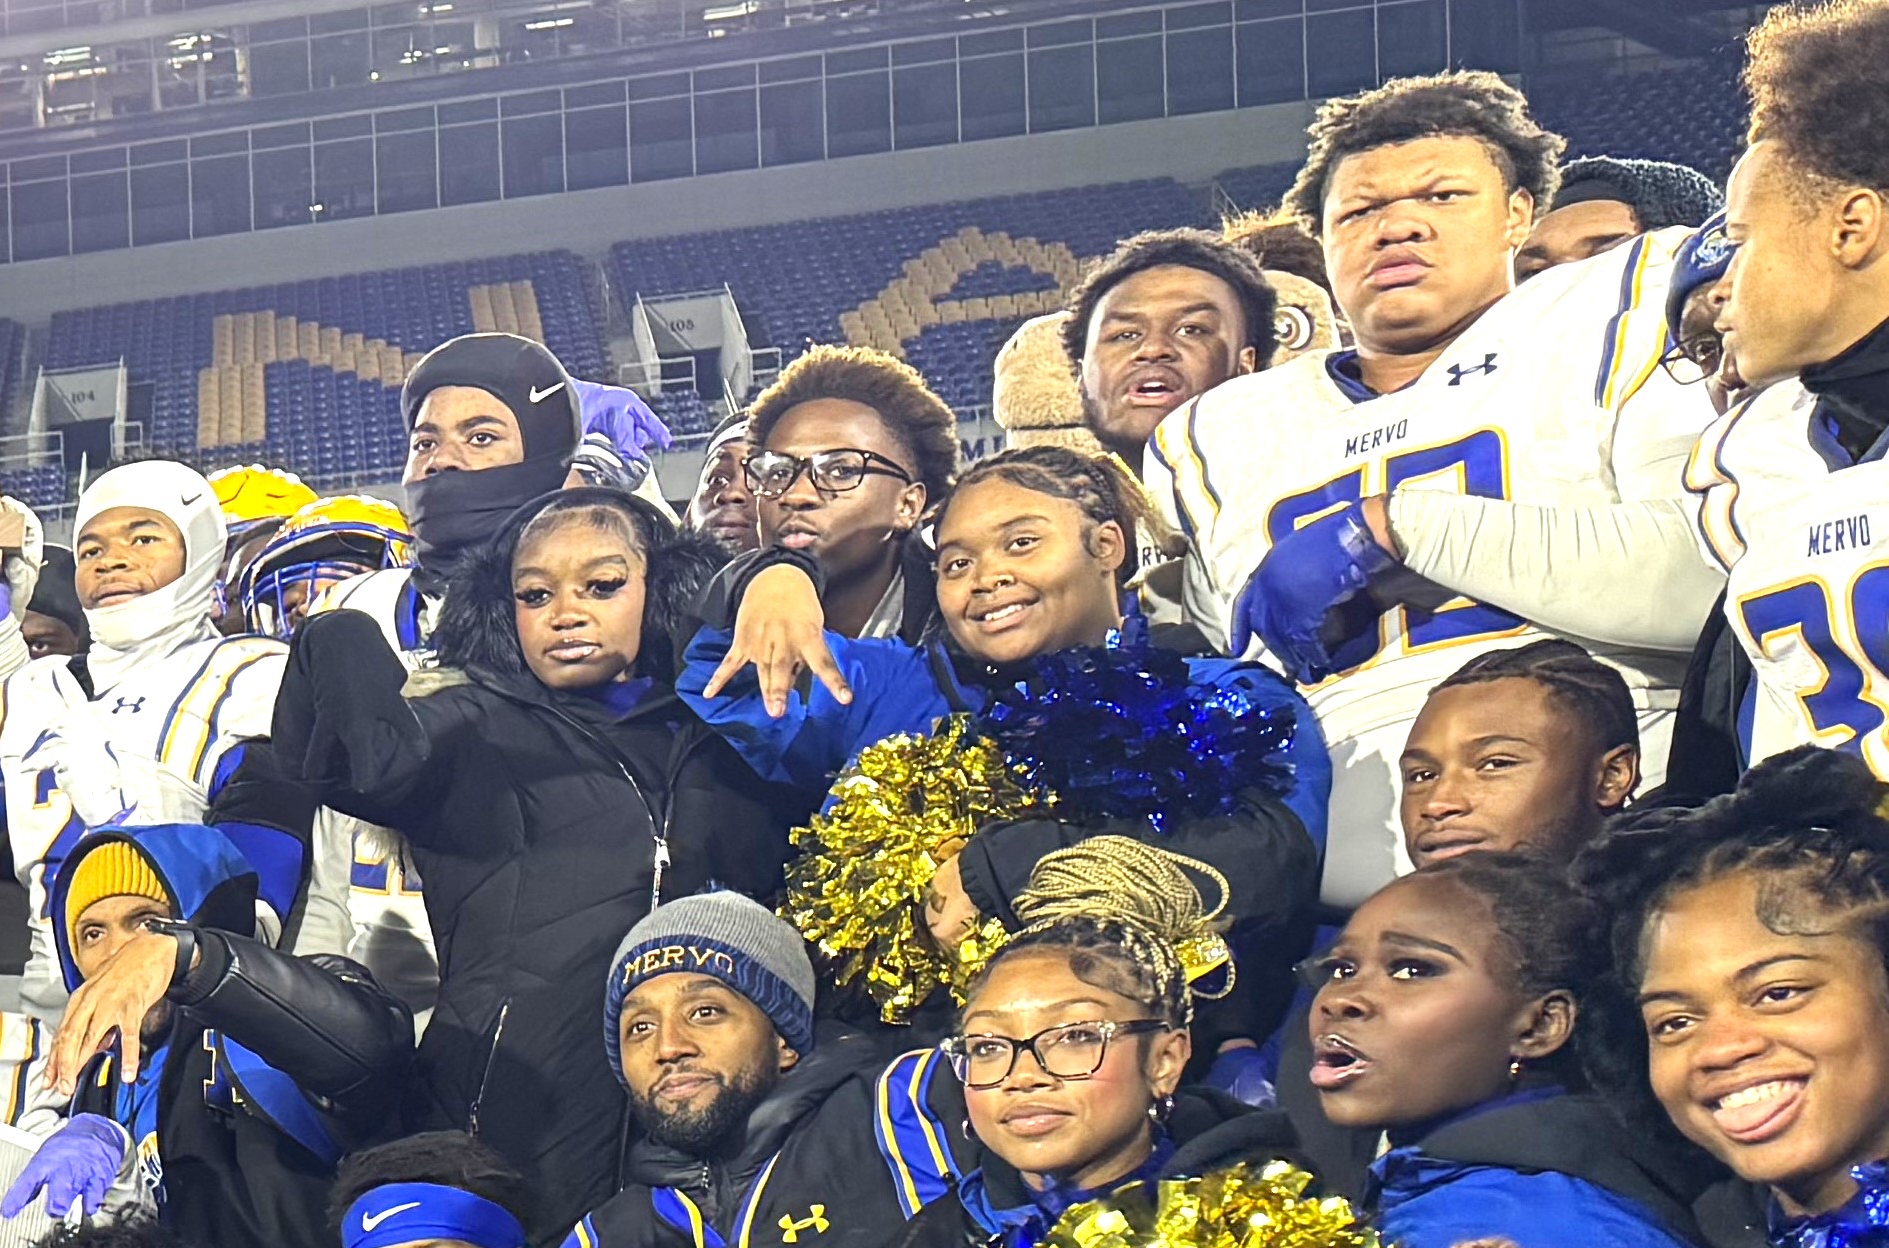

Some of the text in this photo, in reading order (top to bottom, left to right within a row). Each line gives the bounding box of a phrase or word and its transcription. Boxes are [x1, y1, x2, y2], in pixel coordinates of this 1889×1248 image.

[71, 390, 95, 404] 104
[1344, 419, 1408, 458] MERVO
[1807, 514, 1871, 557] MERVO
[1736, 563, 1889, 770] 3
[623, 945, 732, 984] MERVO
